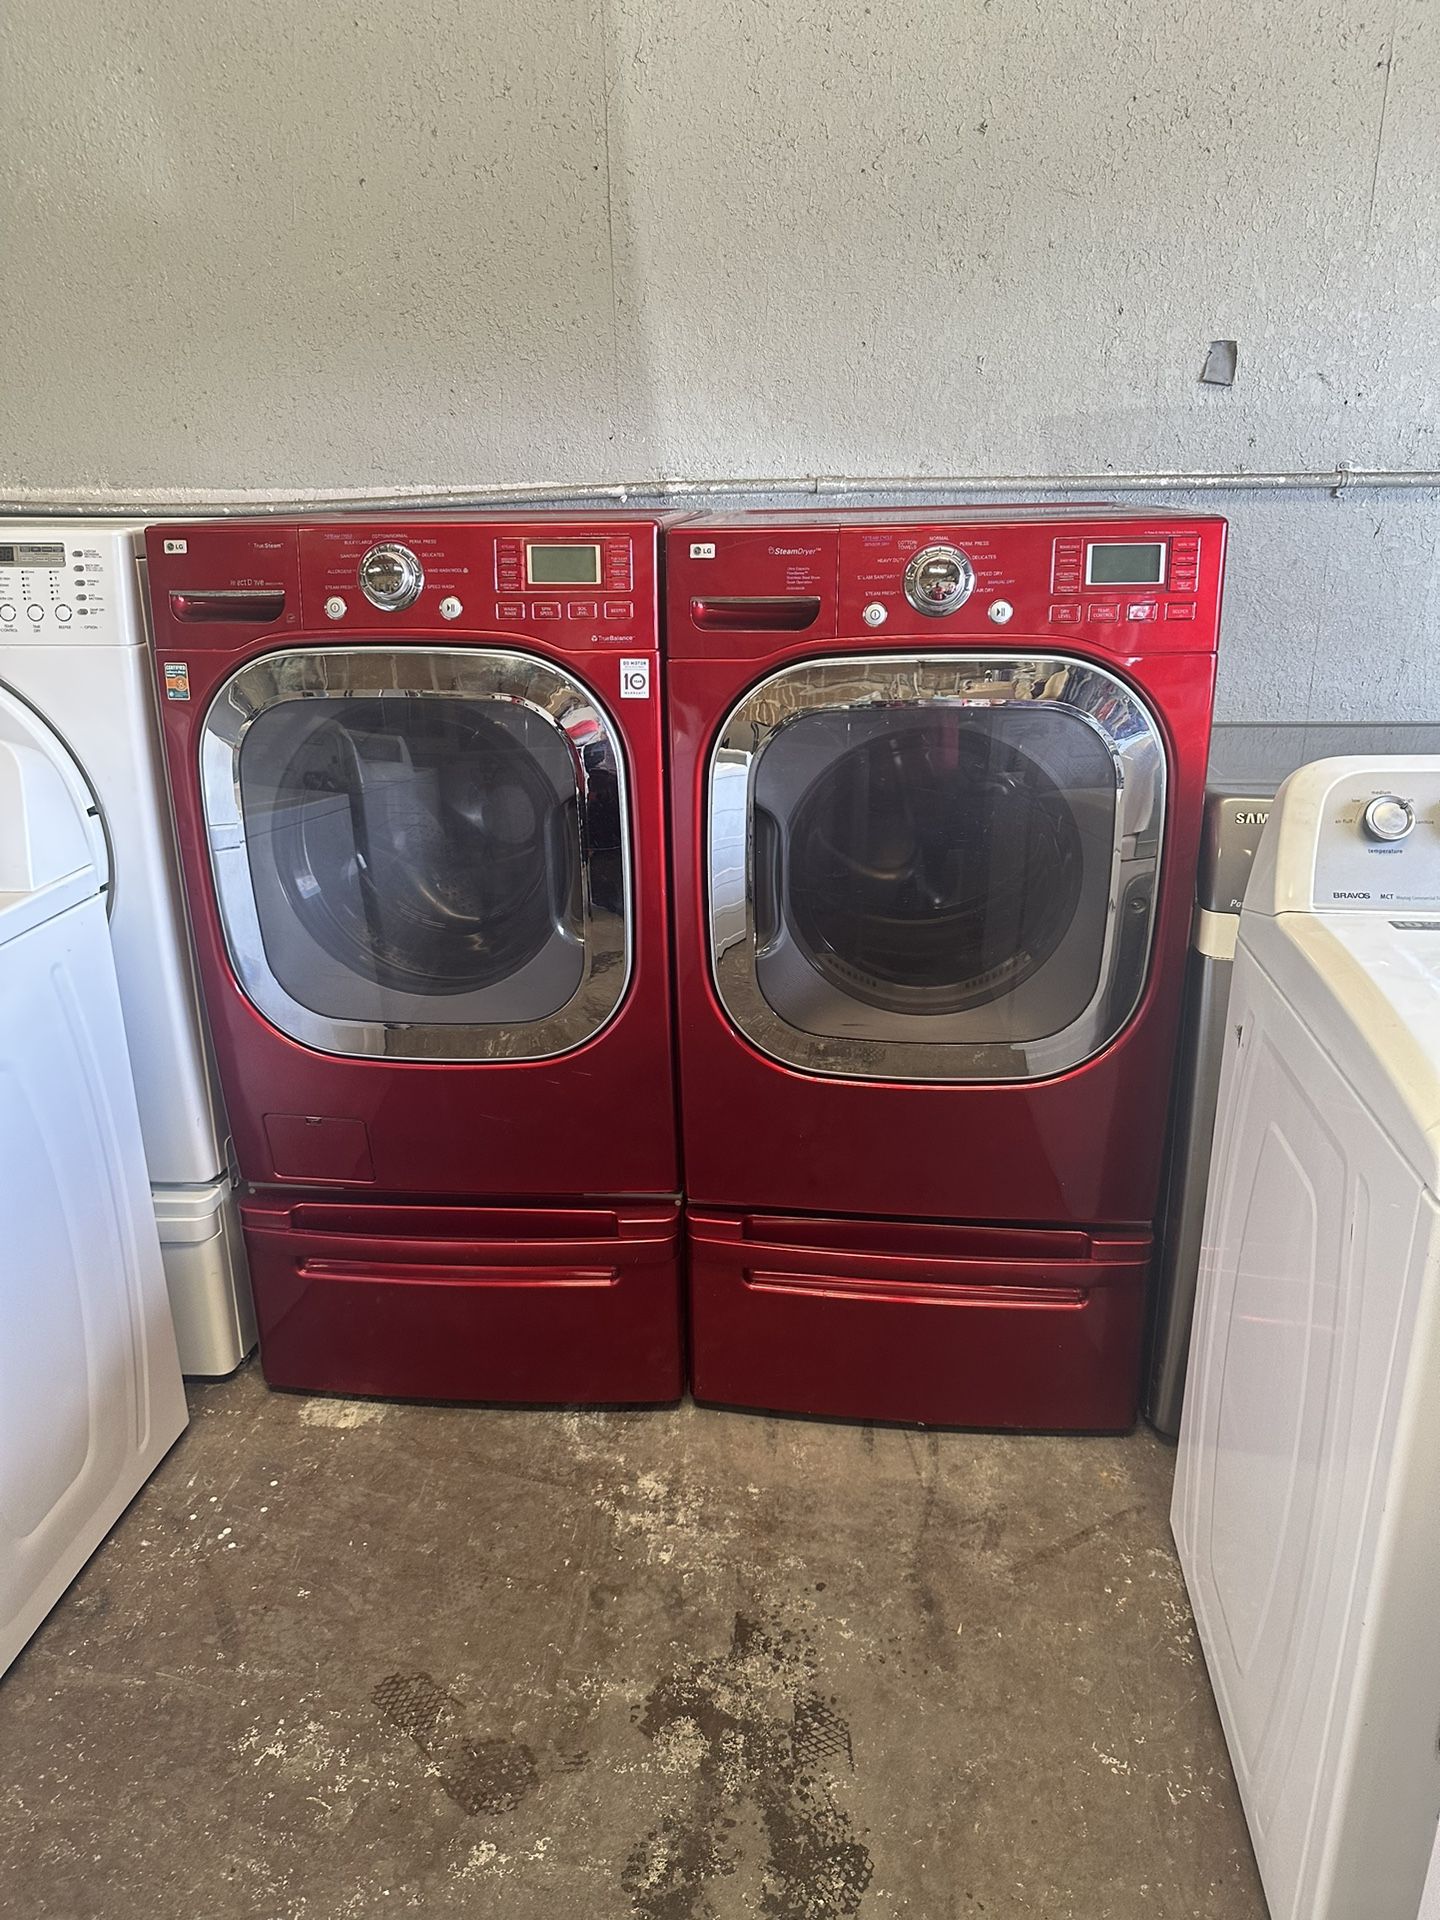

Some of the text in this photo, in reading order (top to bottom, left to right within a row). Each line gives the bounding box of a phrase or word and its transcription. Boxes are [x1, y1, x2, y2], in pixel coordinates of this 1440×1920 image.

[624, 673, 647, 690] 10
[1368, 848, 1403, 856] temperature
[1333, 892, 1371, 900] BRAVOS
